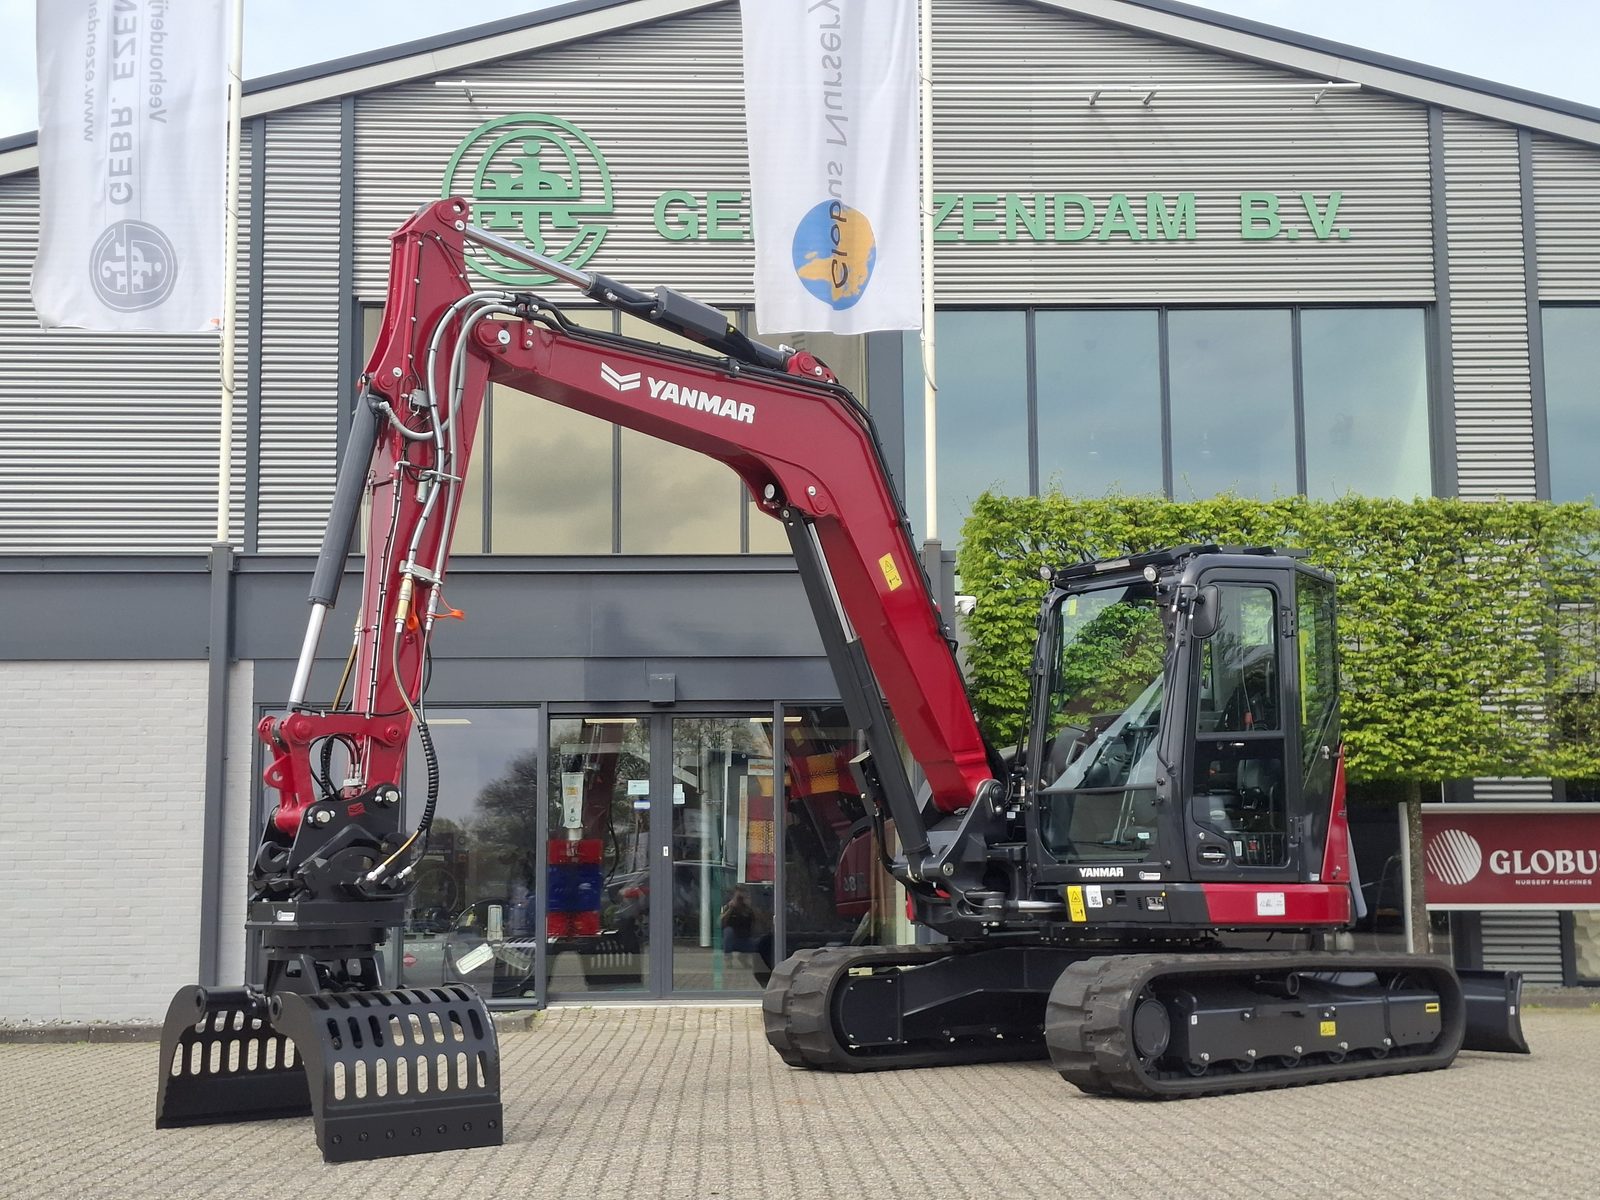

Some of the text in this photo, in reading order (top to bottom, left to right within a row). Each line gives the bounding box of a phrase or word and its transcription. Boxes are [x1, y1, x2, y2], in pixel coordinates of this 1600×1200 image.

[653, 190, 1351, 242] GE ZENDAM B.V.
[646, 376, 756, 424] YANMAR
[1078, 867, 1124, 878] YANMAR
[1489, 849, 1600, 875] GLOBU
